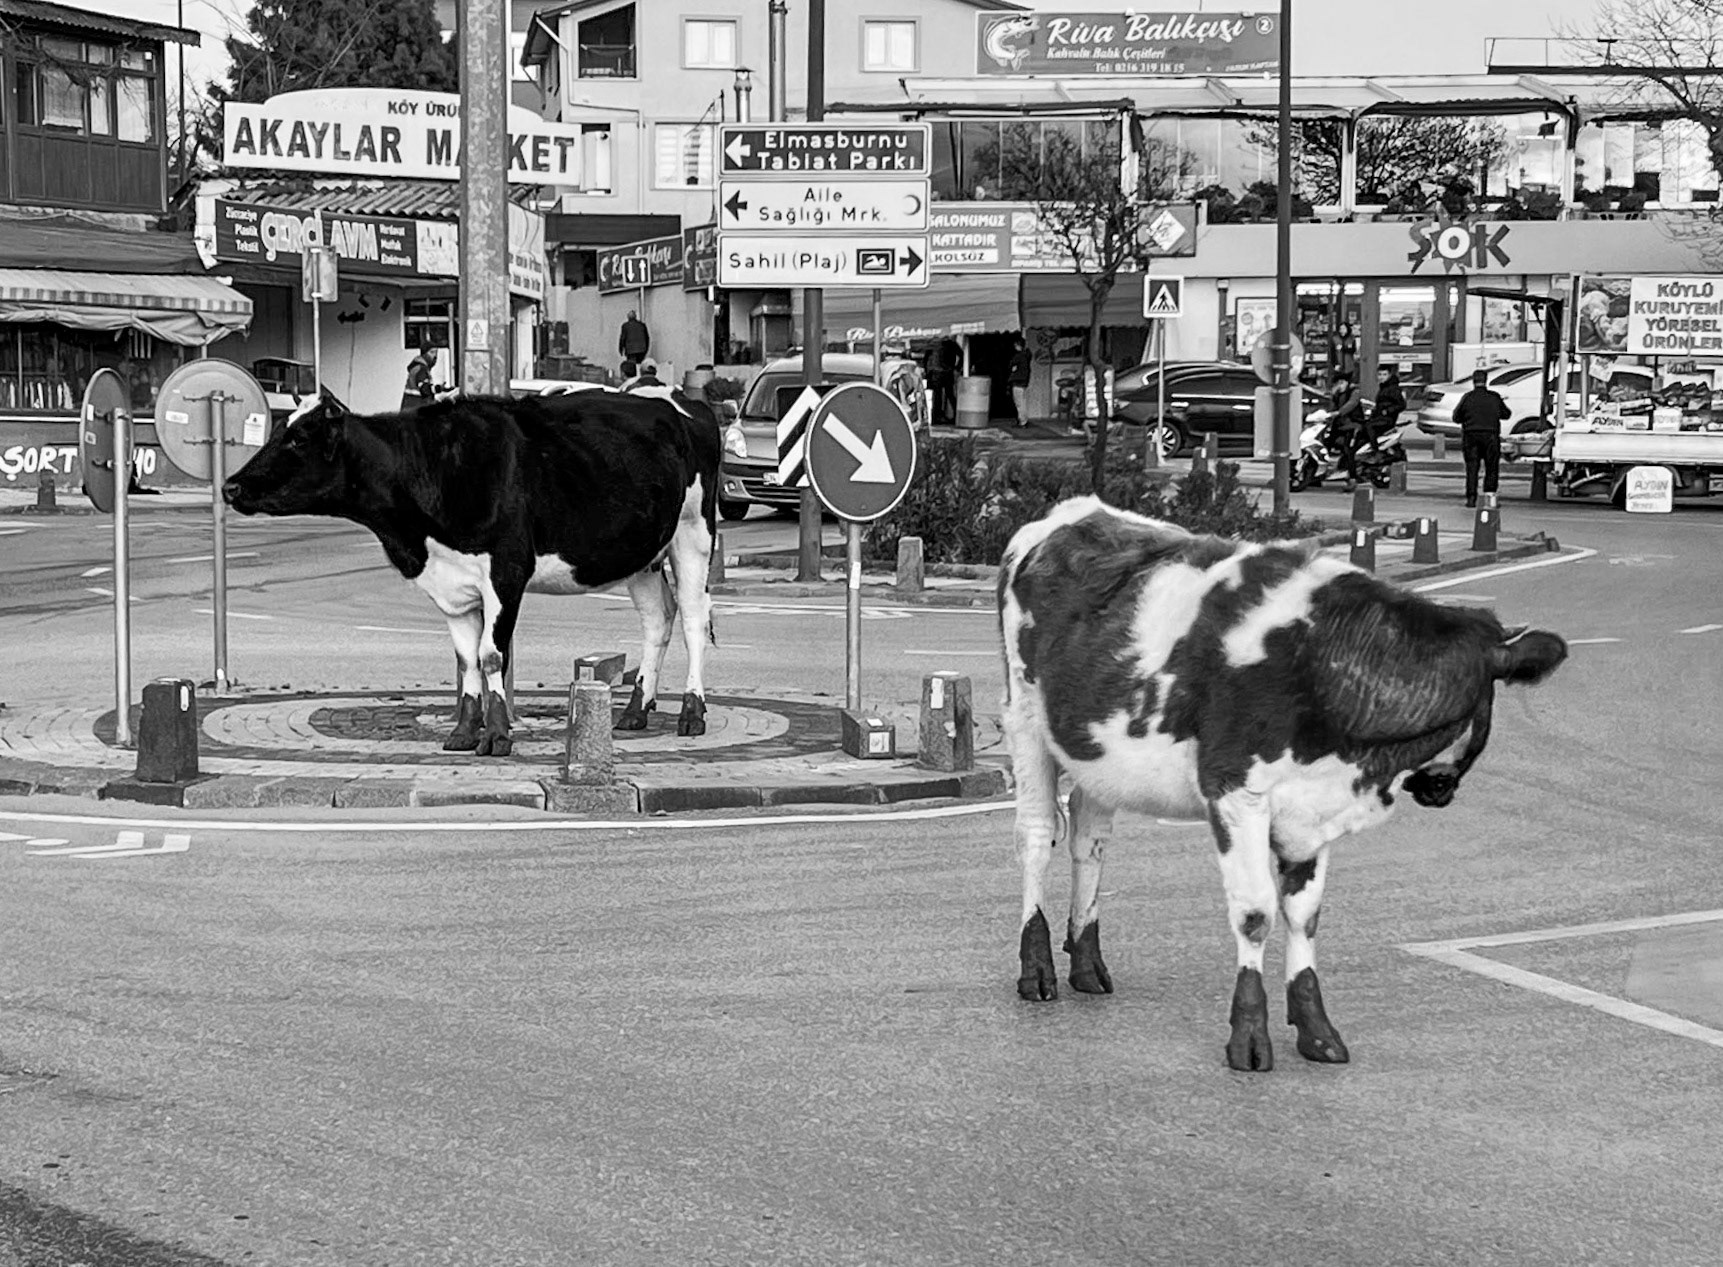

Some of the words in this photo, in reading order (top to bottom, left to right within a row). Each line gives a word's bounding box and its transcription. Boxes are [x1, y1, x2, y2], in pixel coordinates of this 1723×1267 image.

[1047, 17, 1115, 45] Riva
[1124, 13, 1245, 43] Balıkçısı
[1258, 19, 1271, 32] 2
[388, 99, 418, 116] KÖY
[425, 101, 461, 119] ÜRÜ
[232, 116, 402, 163] AKAYLAR
[425, 128, 575, 173] MKET
[764, 131, 908, 149] Elmasburnu
[757, 151, 838, 170] Tabiat
[850, 151, 915, 170] Parkı
[804, 187, 842, 203] Aile
[759, 206, 831, 225] Sağlığı
[842, 206, 887, 222] Mrk.
[930, 214, 1006, 228] SALONUMUZ
[331, 220, 379, 260] AVM
[932, 233, 997, 247] KATTADIR
[729, 252, 785, 270] Sahil
[792, 251, 847, 273] (Plaj)
[934, 252, 985, 263] KOLSÜZ
[1657, 281, 1713, 298] KÖYLÜ
[1634, 299, 1723, 315] KURUYEMİ
[1645, 316, 1721, 332] YÖRESEL
